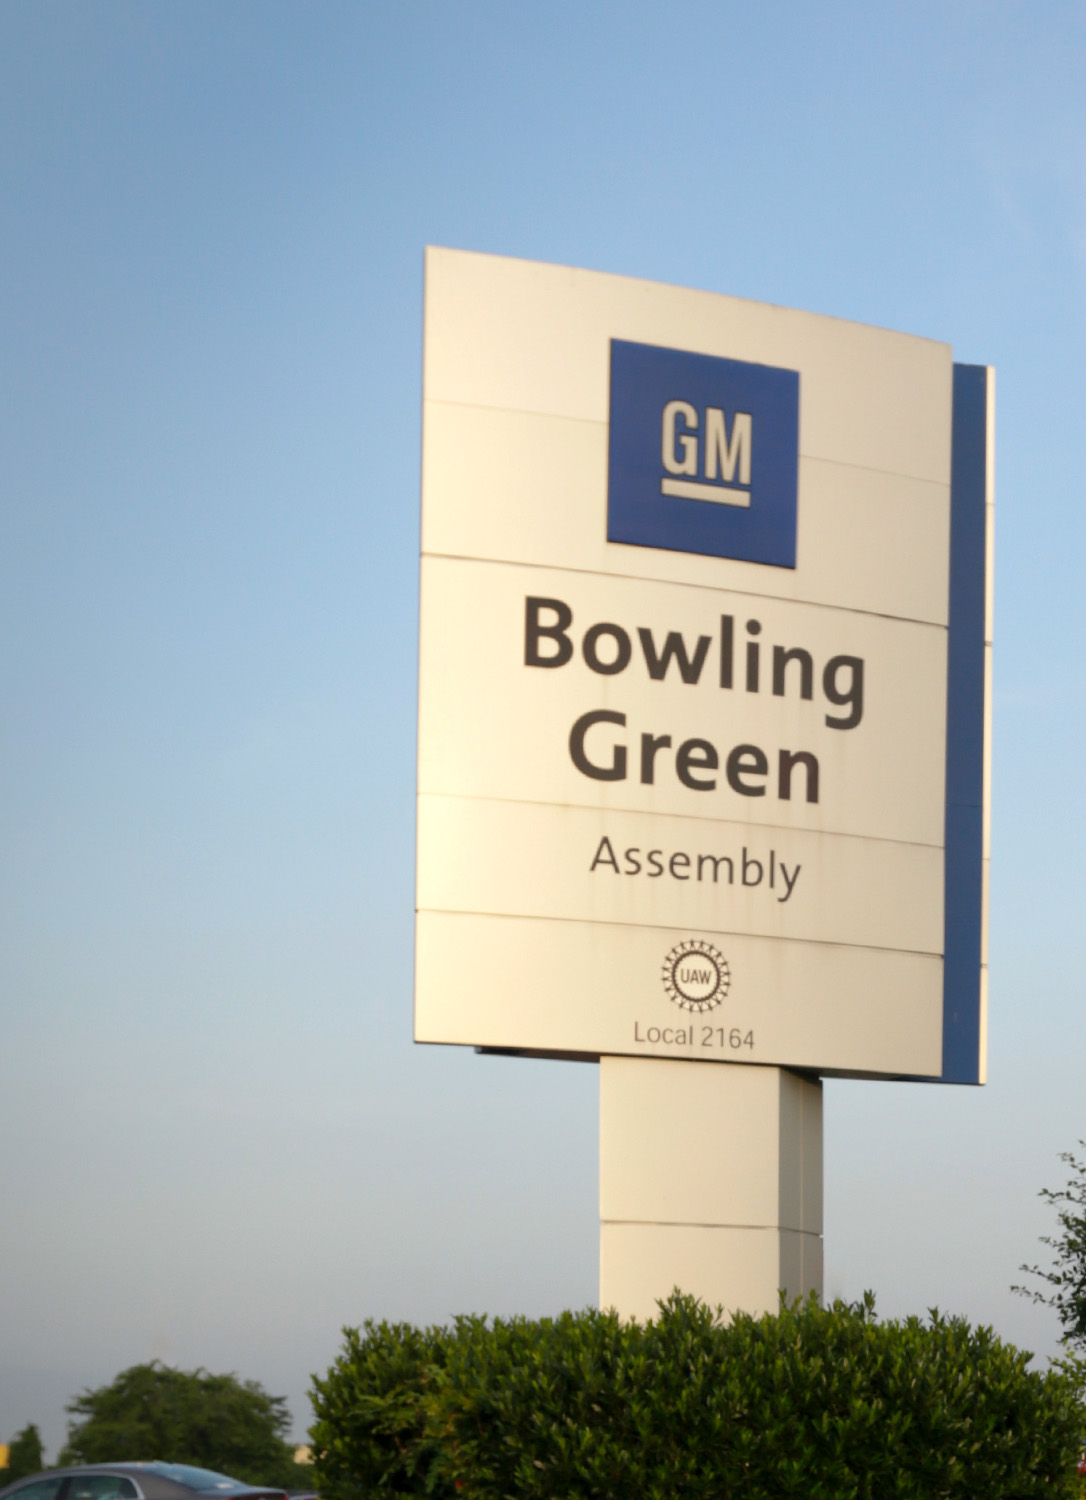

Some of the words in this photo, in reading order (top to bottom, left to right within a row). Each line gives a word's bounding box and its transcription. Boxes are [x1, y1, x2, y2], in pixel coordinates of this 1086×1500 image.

[661, 400, 753, 486] GM
[524, 595, 866, 732] Bowling
[568, 709, 820, 805] Green
[589, 835, 802, 903] Assembly
[680, 968, 712, 985] UAW
[633, 1020, 694, 1046] Local
[701, 1025, 756, 1051] 2164
